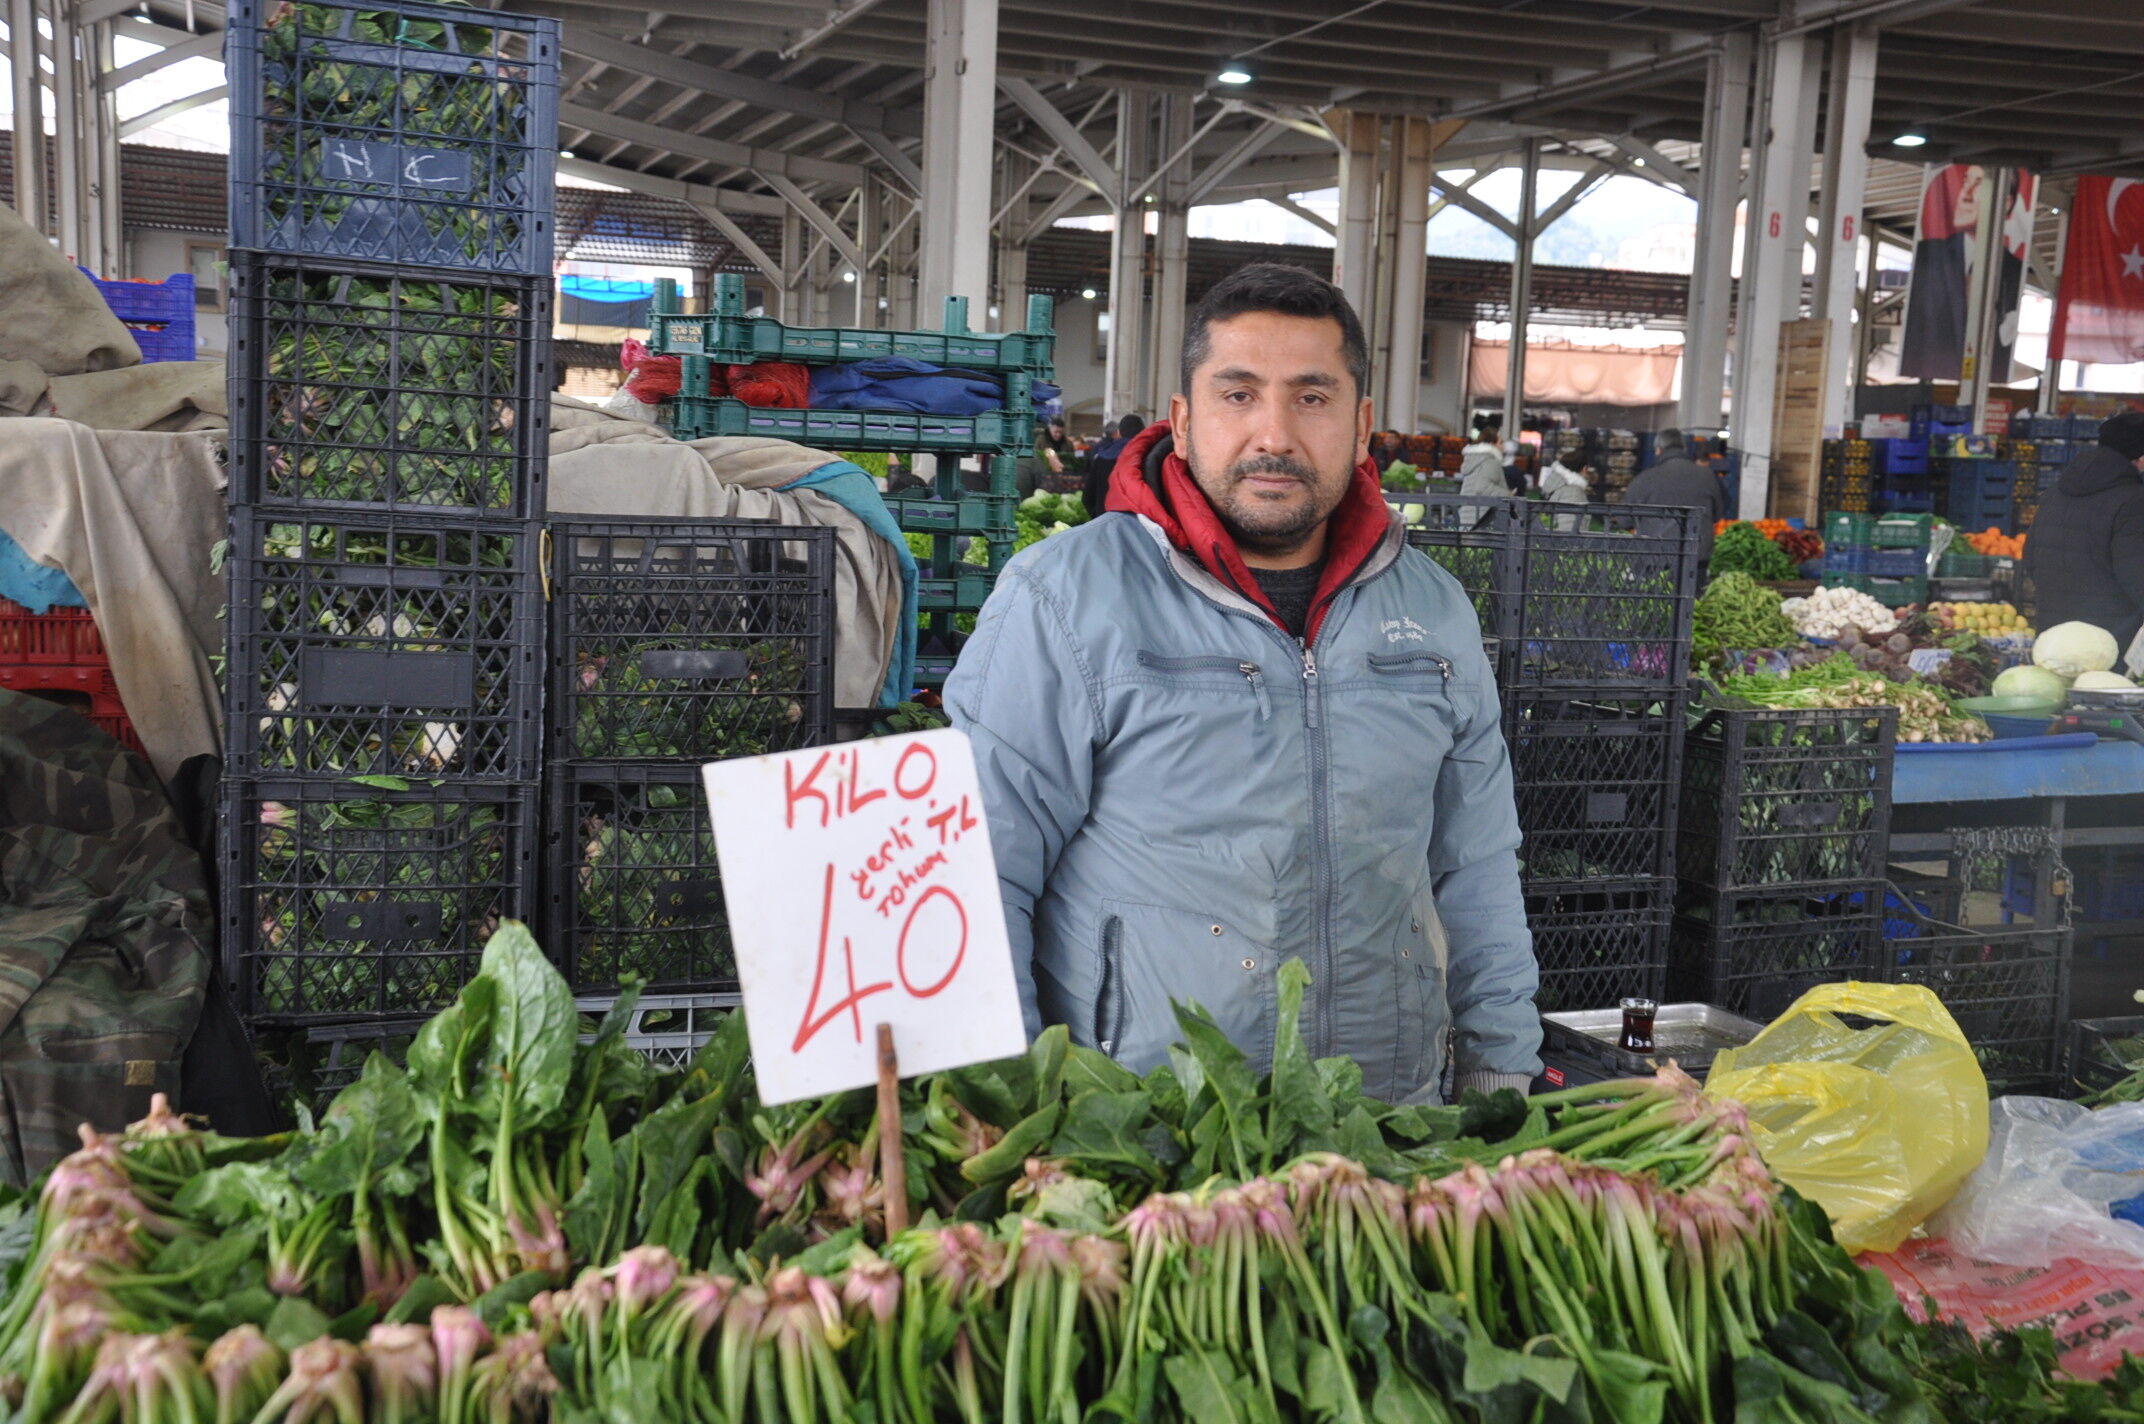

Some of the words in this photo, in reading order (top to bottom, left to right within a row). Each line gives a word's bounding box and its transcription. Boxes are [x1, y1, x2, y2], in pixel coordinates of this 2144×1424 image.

[1769, 212, 1781, 238] 6
[1842, 215, 1854, 241] 6
[792, 863, 967, 1054] 40
